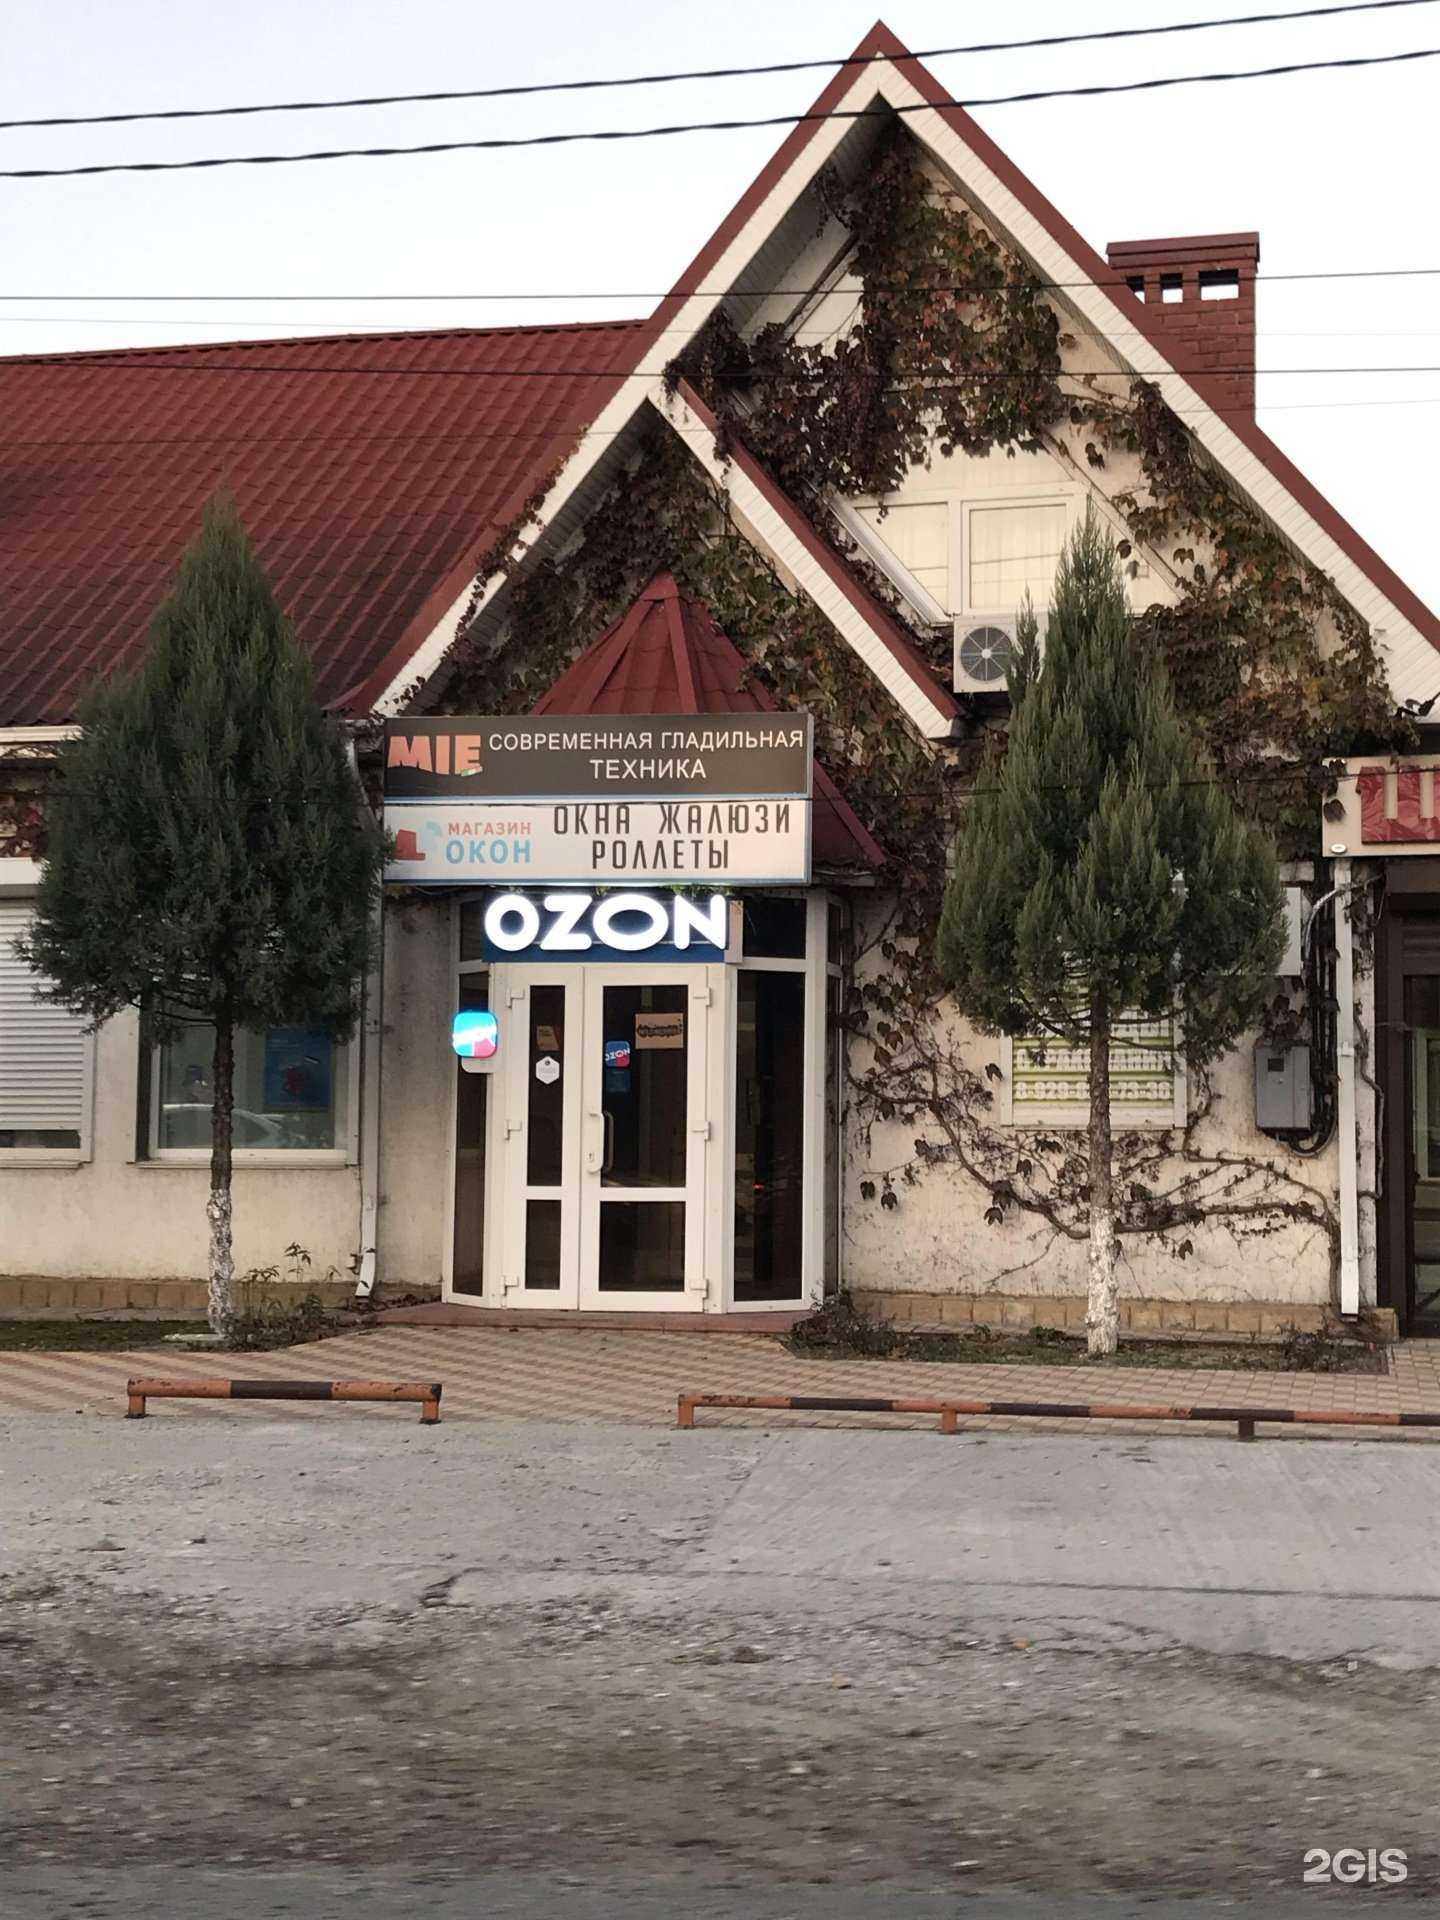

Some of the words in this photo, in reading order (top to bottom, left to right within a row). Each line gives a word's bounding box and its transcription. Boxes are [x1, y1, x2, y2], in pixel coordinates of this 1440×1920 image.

[489, 732, 652, 751] СОВРЕМЕННАЯ
[661, 730, 804, 752] ГЛАДИЛЬНАЯ
[387, 735, 481, 776] MIE
[589, 758, 707, 780] ТЕХНИКА
[447, 822, 533, 836] МАГАЗИН
[553, 803, 630, 835] ОКНА
[658, 803, 790, 835] ЖАЛЮЗИ
[445, 839, 533, 865] ОКОН
[592, 839, 729, 869] РОЛЛЕТЫ
[484, 894, 727, 951] OZON
